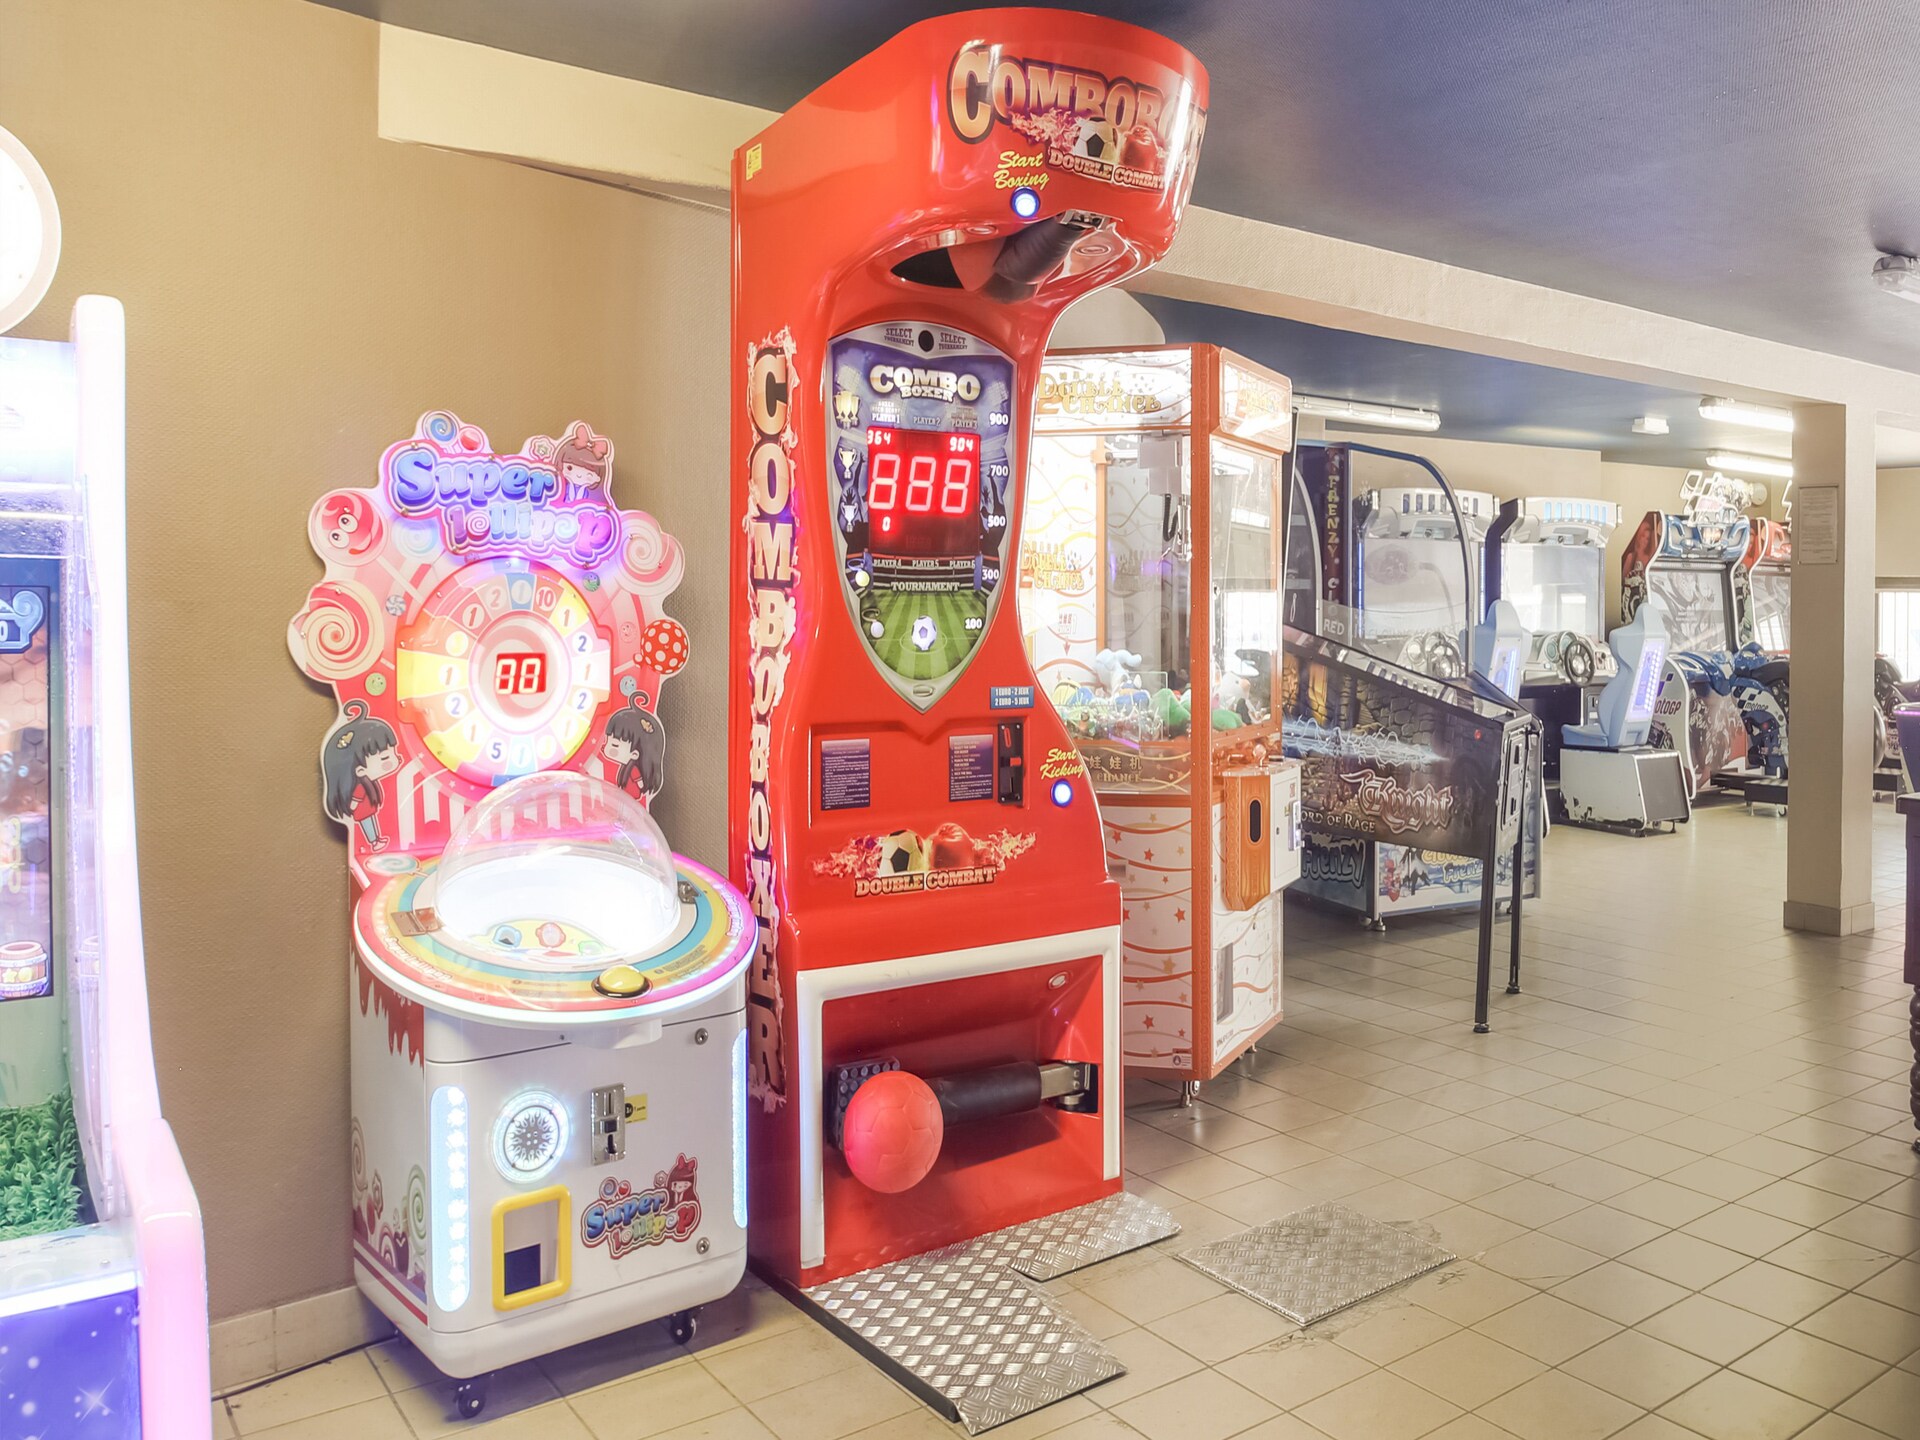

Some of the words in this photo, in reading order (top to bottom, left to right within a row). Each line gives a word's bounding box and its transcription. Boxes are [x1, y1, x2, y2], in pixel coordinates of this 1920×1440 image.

[997, 150, 1043, 169] Start
[1048, 148, 1113, 182] DOUBLE
[1114, 166, 1168, 190] COMBAT
[993, 170, 1050, 191] Boxing
[884, 335, 915, 347] TOURNAMENT
[885, 327, 913, 339] SELECT
[940, 332, 967, 345] SELECT
[938, 342, 968, 351] TOURNAMENT
[870, 363, 982, 401] COMBO
[899, 384, 954, 403] BOXER
[1061, 394, 1162, 415] CHANCE
[871, 412, 896, 423] PLAYER
[913, 416, 936, 425] PLAYER
[951, 419, 973, 428] PLAYER
[989, 412, 1009, 425] 900
[867, 430, 891, 445] 364
[949, 436, 974, 452] 904
[395, 448, 556, 507] Super
[990, 464, 1009, 477] 700
[448, 501, 613, 558] lollipop
[882, 516, 891, 532] 0
[987, 515, 1006, 528] 500
[873, 559, 897, 567] PLAYER
[912, 559, 935, 568] PLAYER
[949, 560, 971, 568] PLAYER
[981, 569, 1000, 580] 300
[890, 581, 960, 592] TOURNAMENT
[538, 587, 555, 608] 10
[469, 606, 479, 626] 1
[563, 608, 571, 627] 1
[964, 618, 983, 630] 100
[1323, 619, 1345, 635] RED
[577, 634, 588, 653] 2
[445, 667, 453, 686] 1
[451, 696, 462, 715] 2
[577, 692, 588, 710] 2
[491, 741, 503, 760] 5
[1046, 748, 1078, 763] Start
[1040, 760, 1085, 780] Kicking
[1301, 810, 1324, 824] ORD
[1326, 815, 1341, 827] OF
[1344, 813, 1376, 833] RAGE
[1443, 860, 1483, 883] Frenz
[855, 872, 925, 897] DOUBLE
[926, 865, 998, 888] COMBAT
[586, 1191, 666, 1240] Super
[612, 1204, 697, 1252] lollipop
